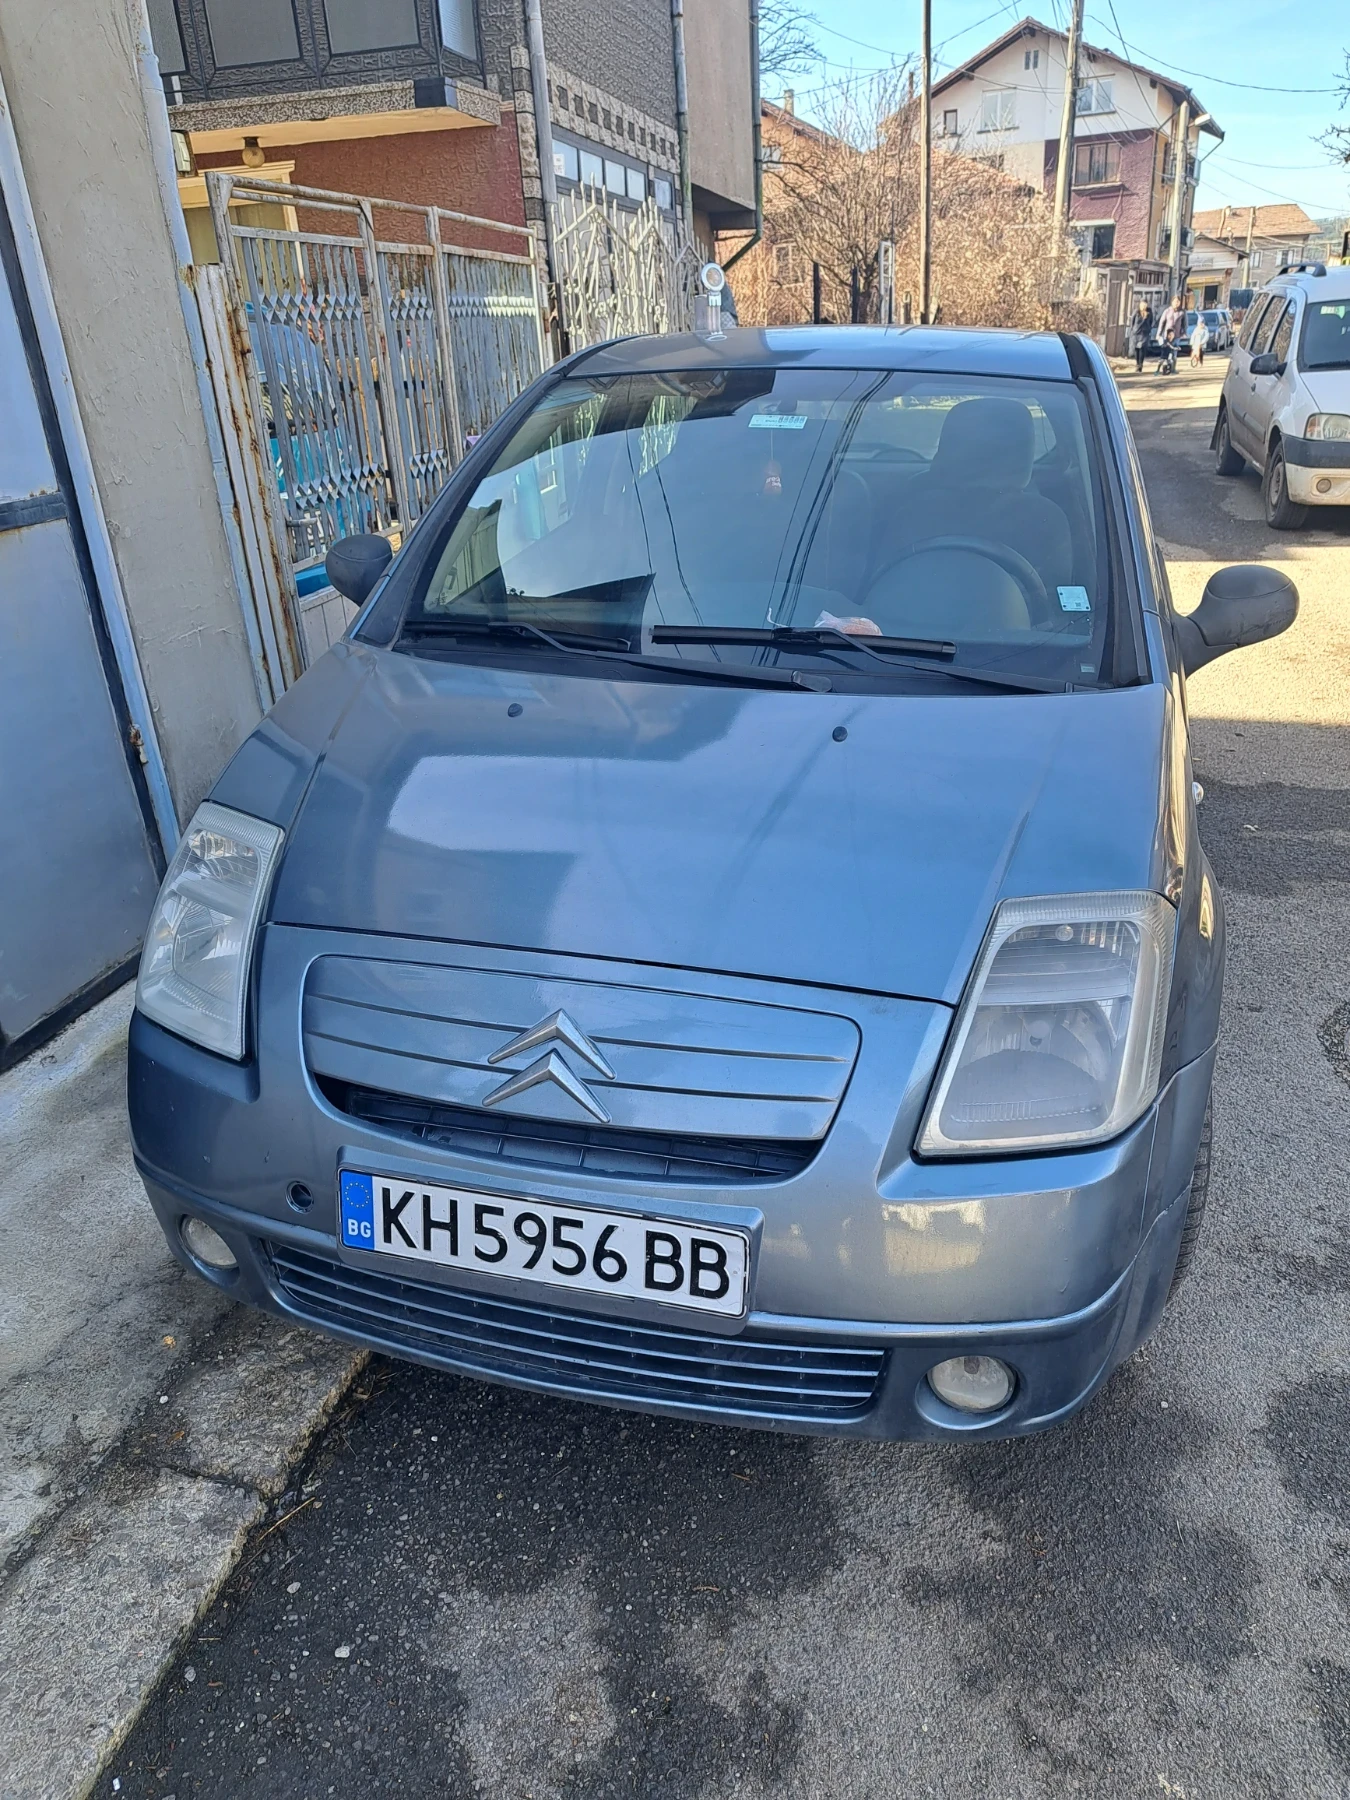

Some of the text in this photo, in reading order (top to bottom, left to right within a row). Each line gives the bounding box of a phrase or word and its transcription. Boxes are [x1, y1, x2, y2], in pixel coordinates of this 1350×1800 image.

[347, 1218, 372, 1239] BG
[381, 1187, 730, 1300] KH 5956 BB
